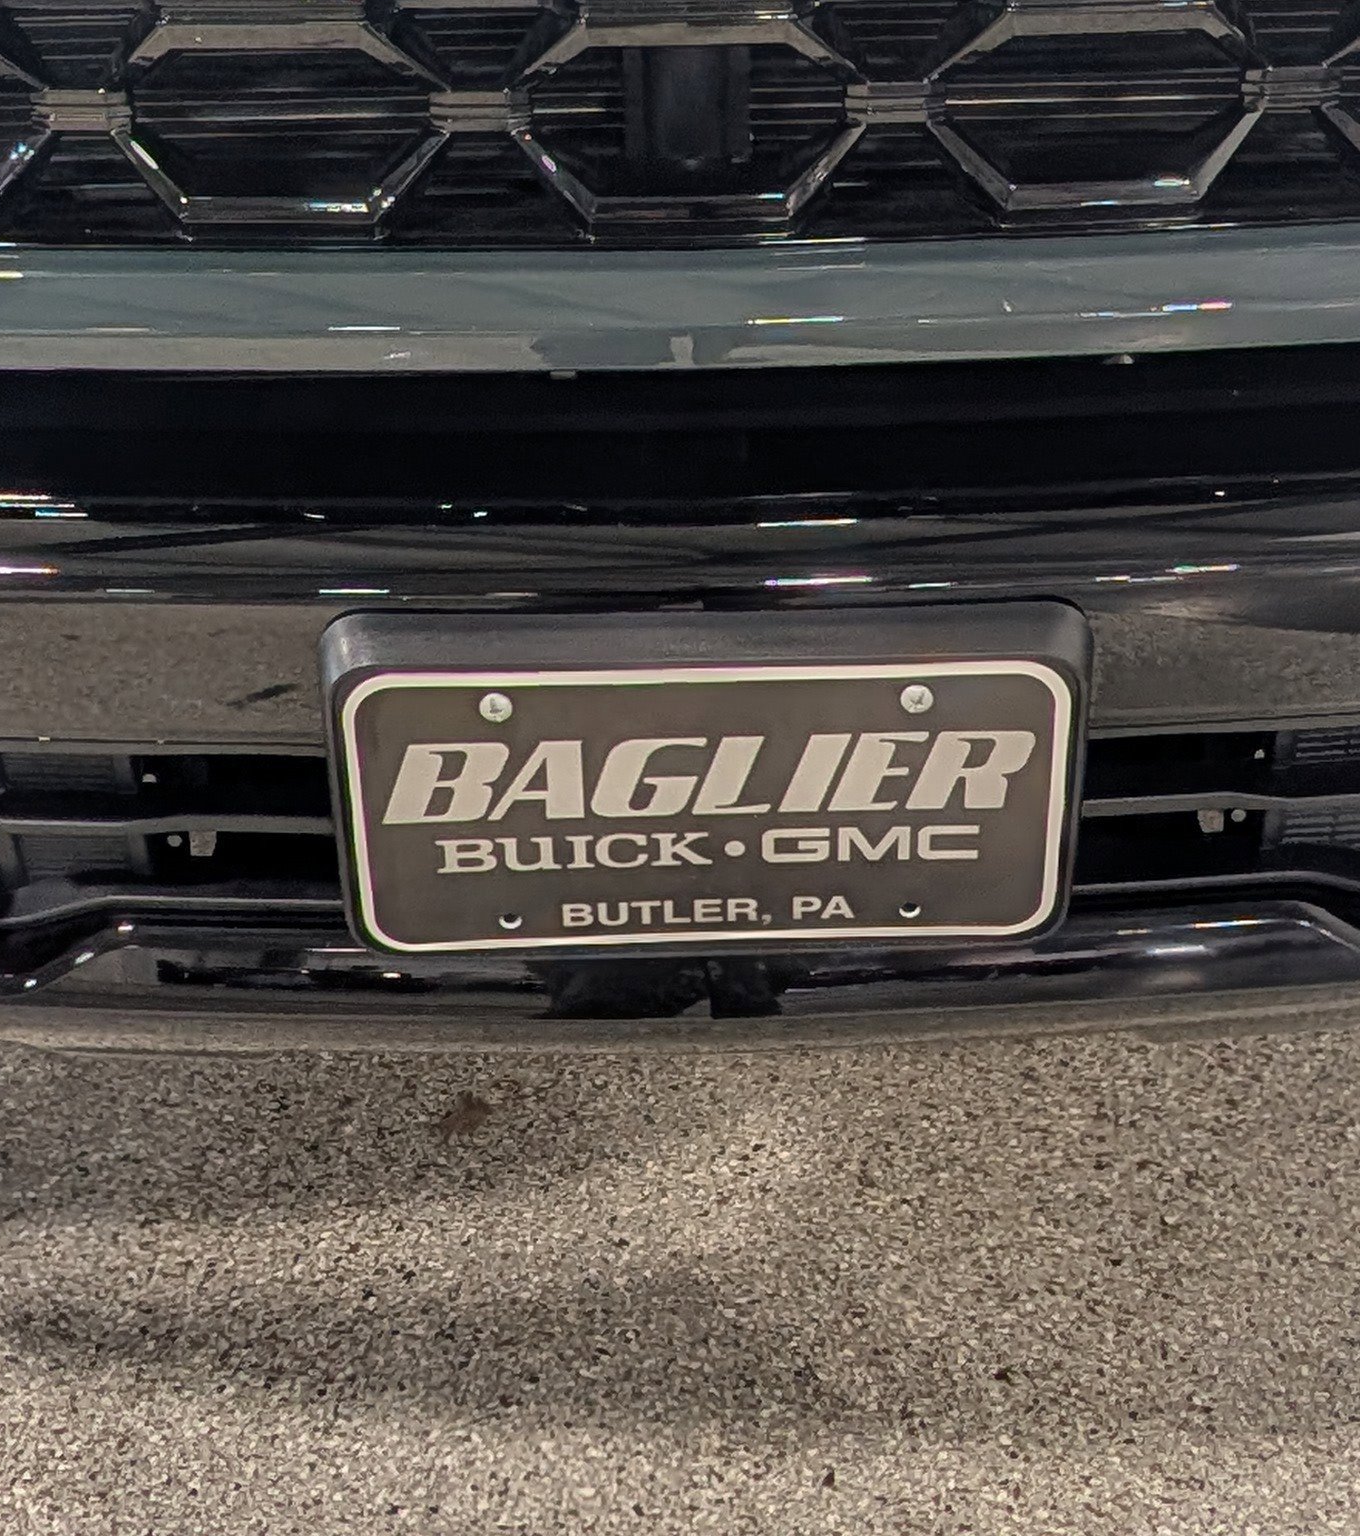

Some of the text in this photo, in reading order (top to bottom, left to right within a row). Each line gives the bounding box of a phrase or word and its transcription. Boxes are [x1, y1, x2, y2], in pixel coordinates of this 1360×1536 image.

[382, 730, 1035, 825] BAGLIER
[436, 825, 980, 874] BUICK GMC
[562, 895, 855, 928] BUTLER, PA
